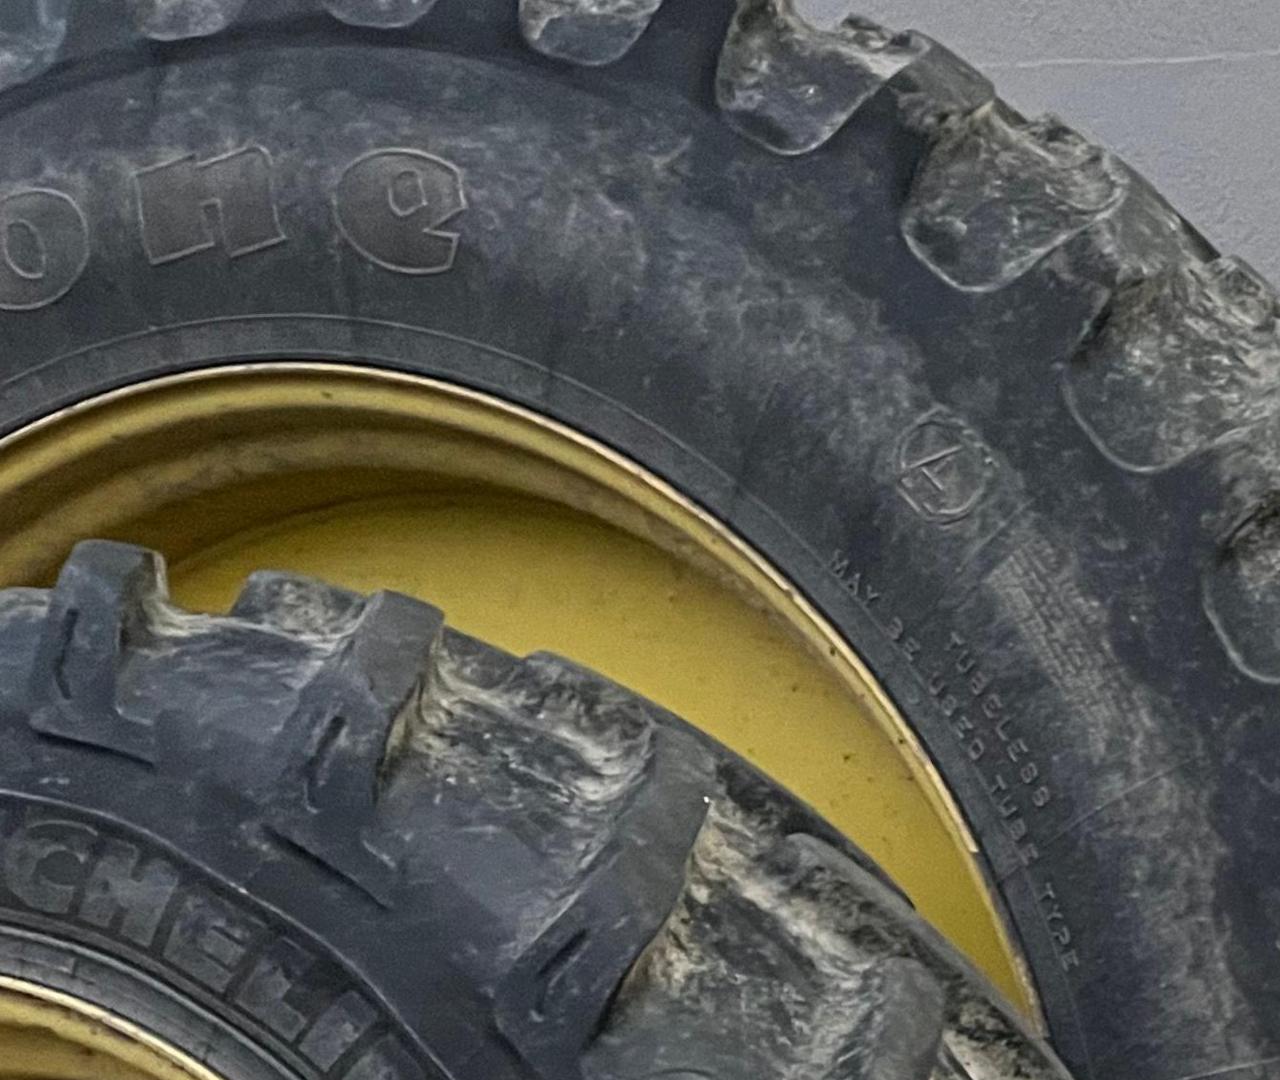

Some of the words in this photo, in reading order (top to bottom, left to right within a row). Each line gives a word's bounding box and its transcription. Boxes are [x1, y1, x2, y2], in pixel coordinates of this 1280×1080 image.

[828, 549, 881, 602] MAY
[928, 670, 985, 761] USED
[991, 773, 1040, 866] TUBE
[1038, 881, 1080, 972] TYPE
[950, 631, 1050, 808] TUBELESS
